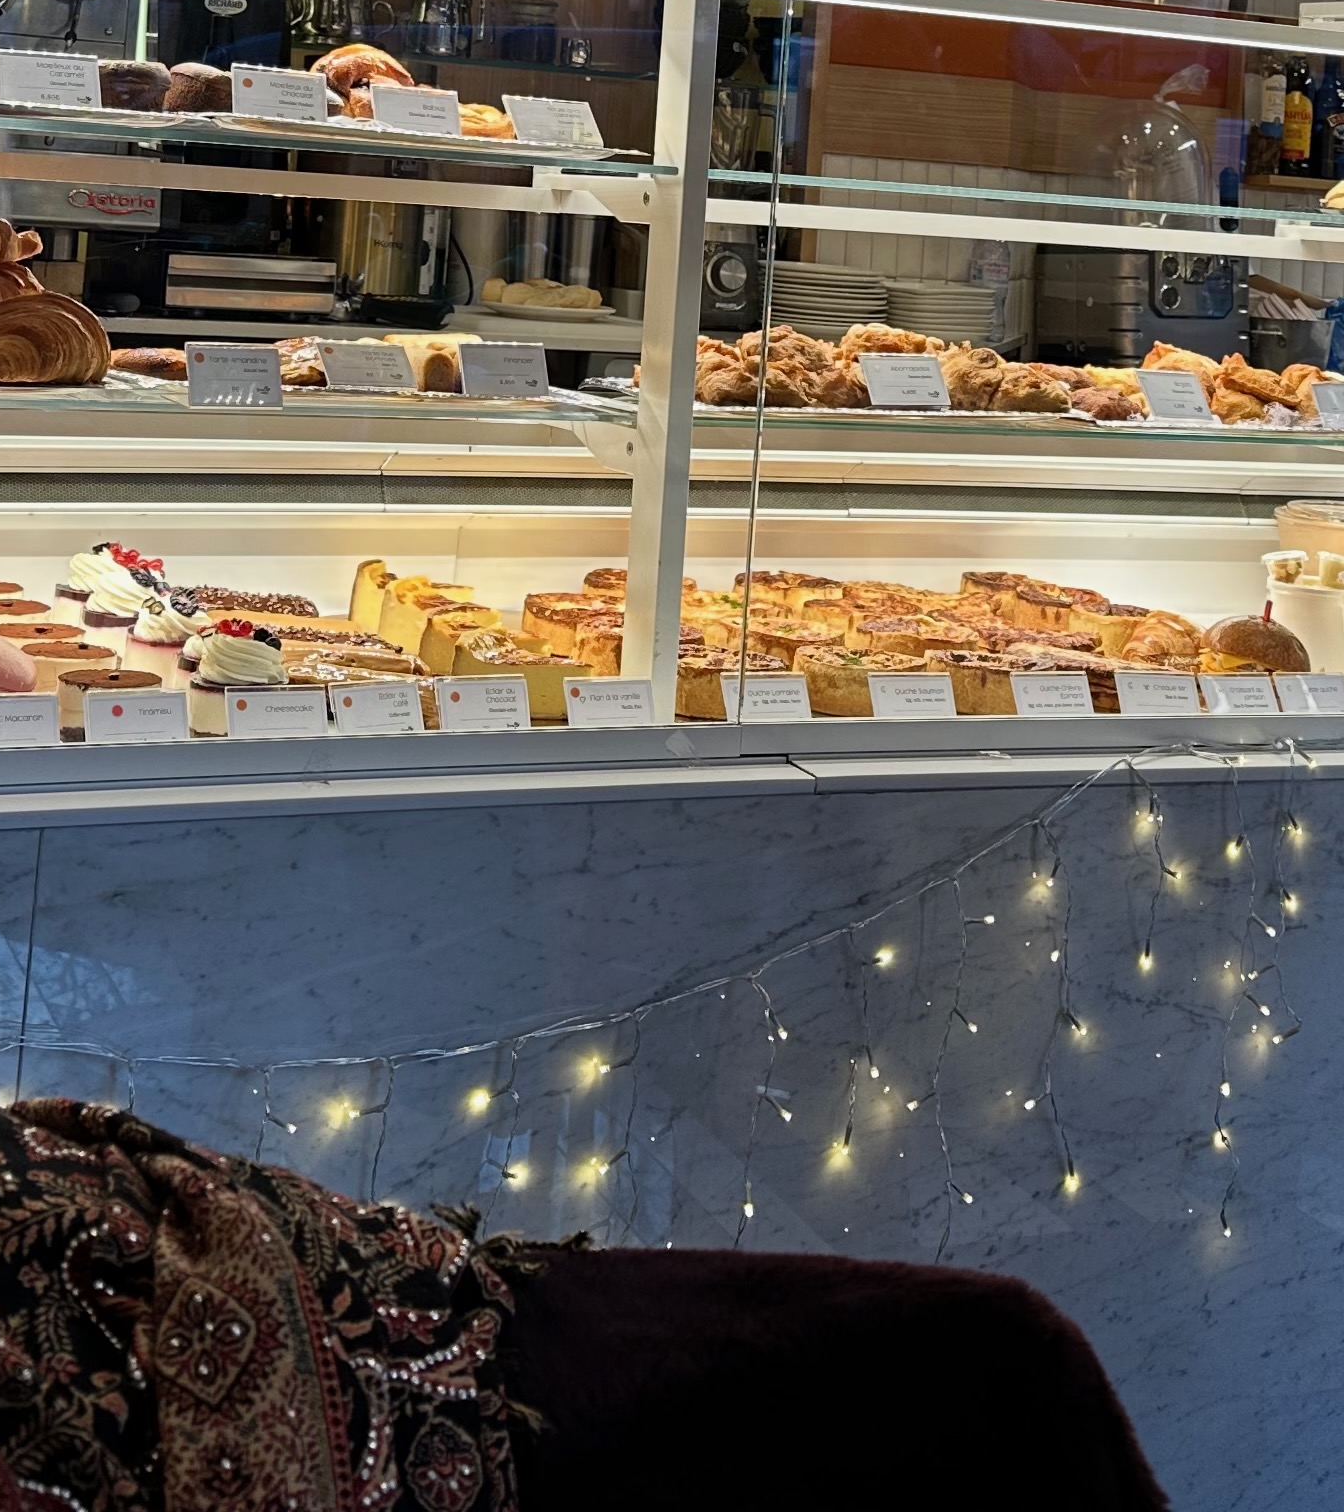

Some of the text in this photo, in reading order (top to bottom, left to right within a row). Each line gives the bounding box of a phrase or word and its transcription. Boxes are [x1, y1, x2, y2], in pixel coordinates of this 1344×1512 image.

[747, 689, 771, 698] Quiche
[894, 688, 917, 696] Quiche
[138, 706, 172, 718] Tiramisu
[264, 702, 314, 714] Cheesecake
[4, 712, 43, 725] Macaron
